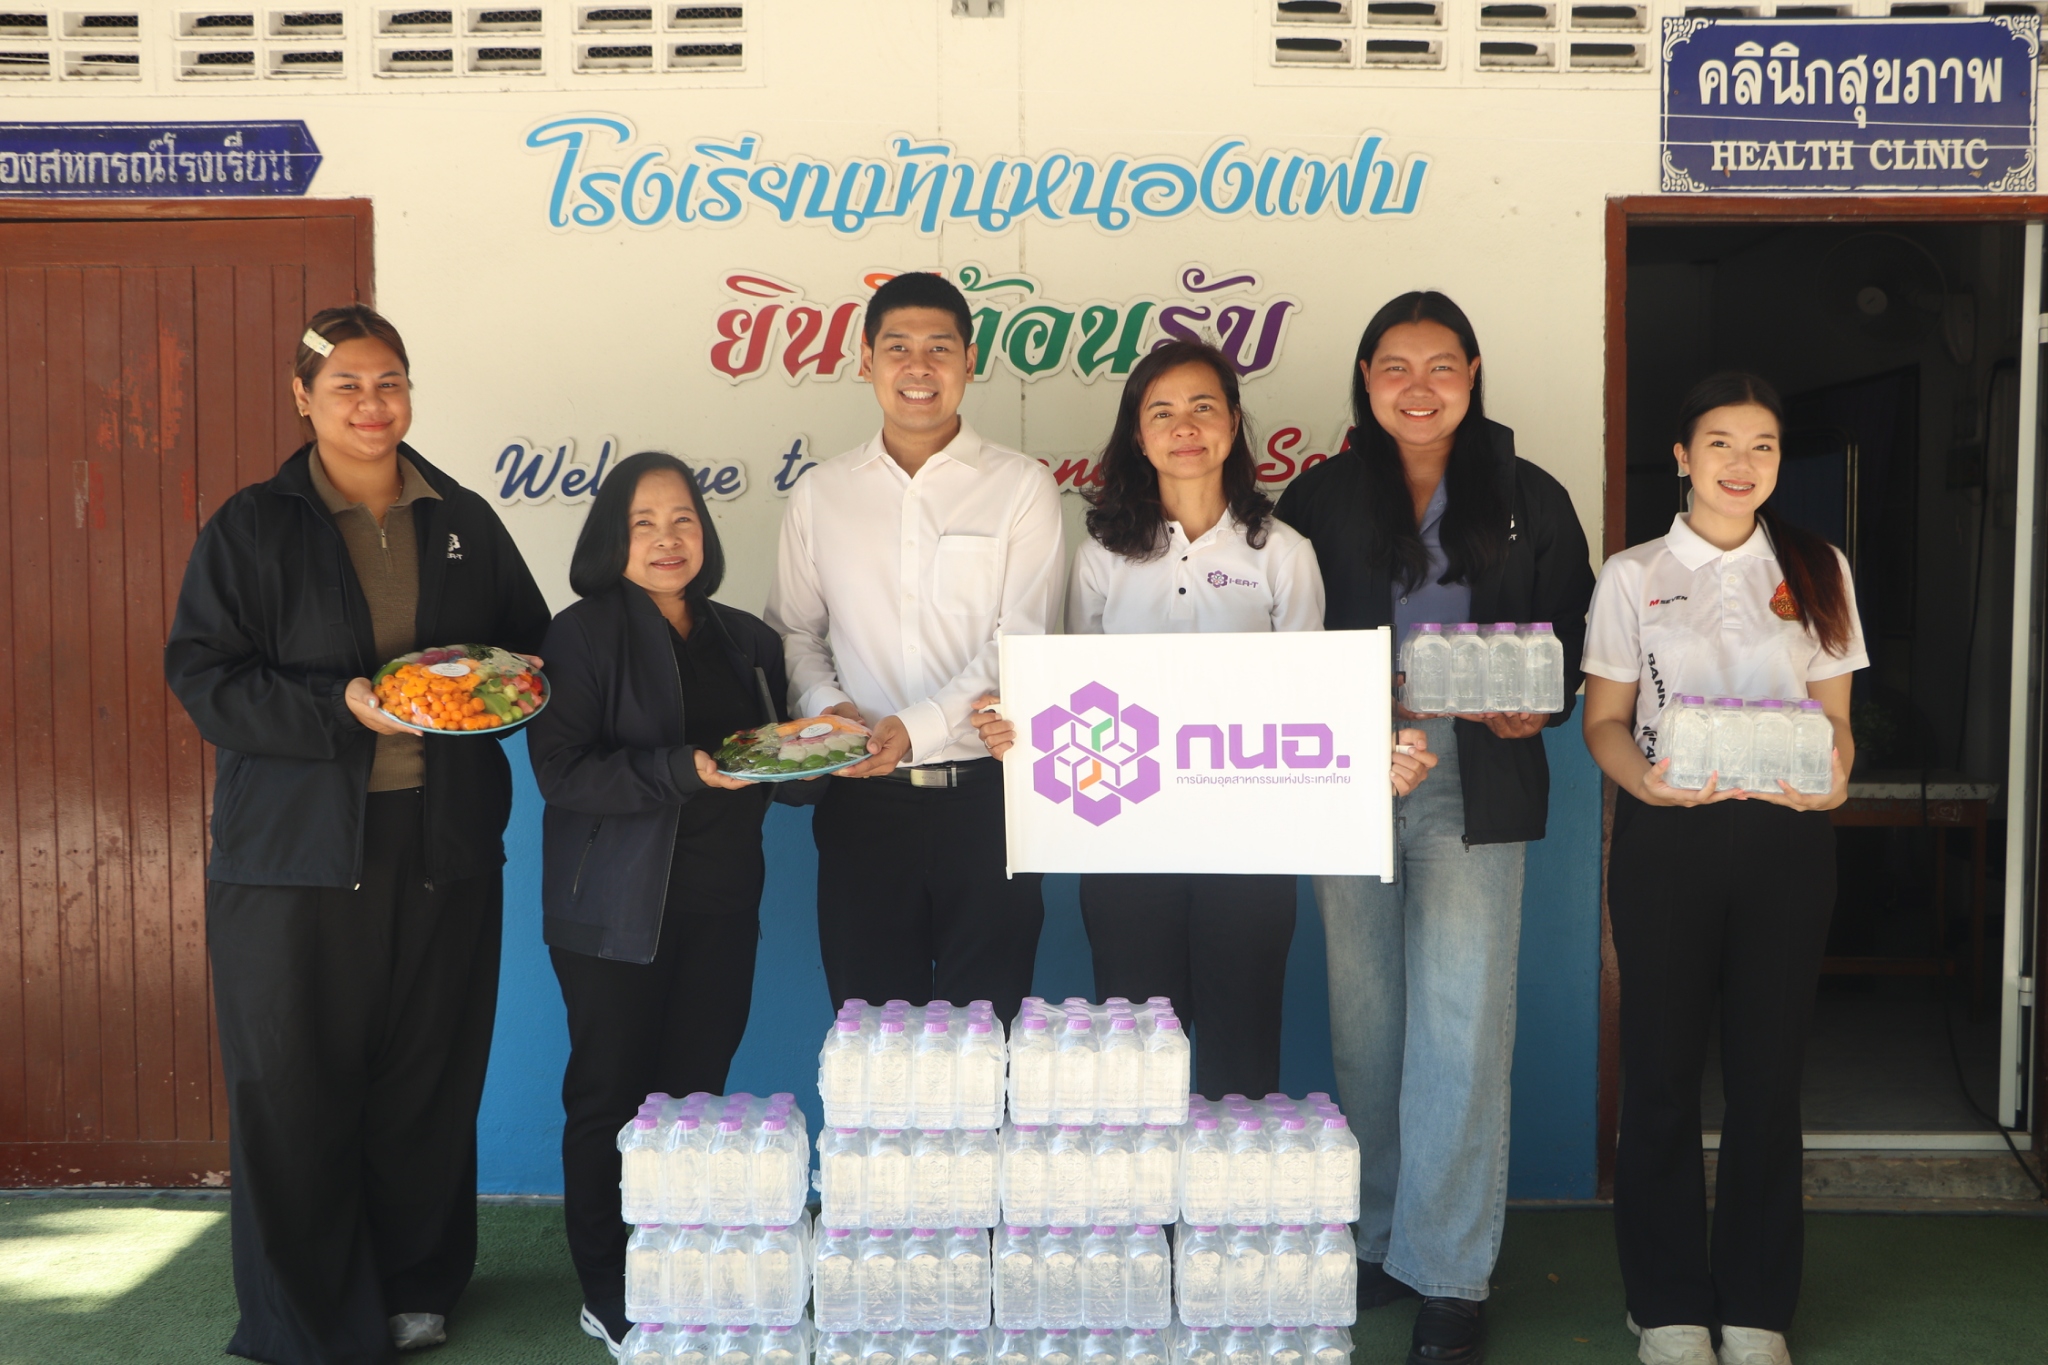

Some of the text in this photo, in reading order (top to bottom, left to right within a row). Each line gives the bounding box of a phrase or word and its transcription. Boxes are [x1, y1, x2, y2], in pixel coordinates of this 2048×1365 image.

[1699, 41, 2003, 129] คลินิกสุขภาพ
[525, 117, 1428, 233] โรงเรียนบ้านหนองแฟบ
[1711, 138, 1989, 172] HEALTH CLINIC
[1176, 723, 1351, 769] กนอ.
[1176, 772, 1351, 787] การนิคมอุตสาหกรรมแห่งประเทศไทย
